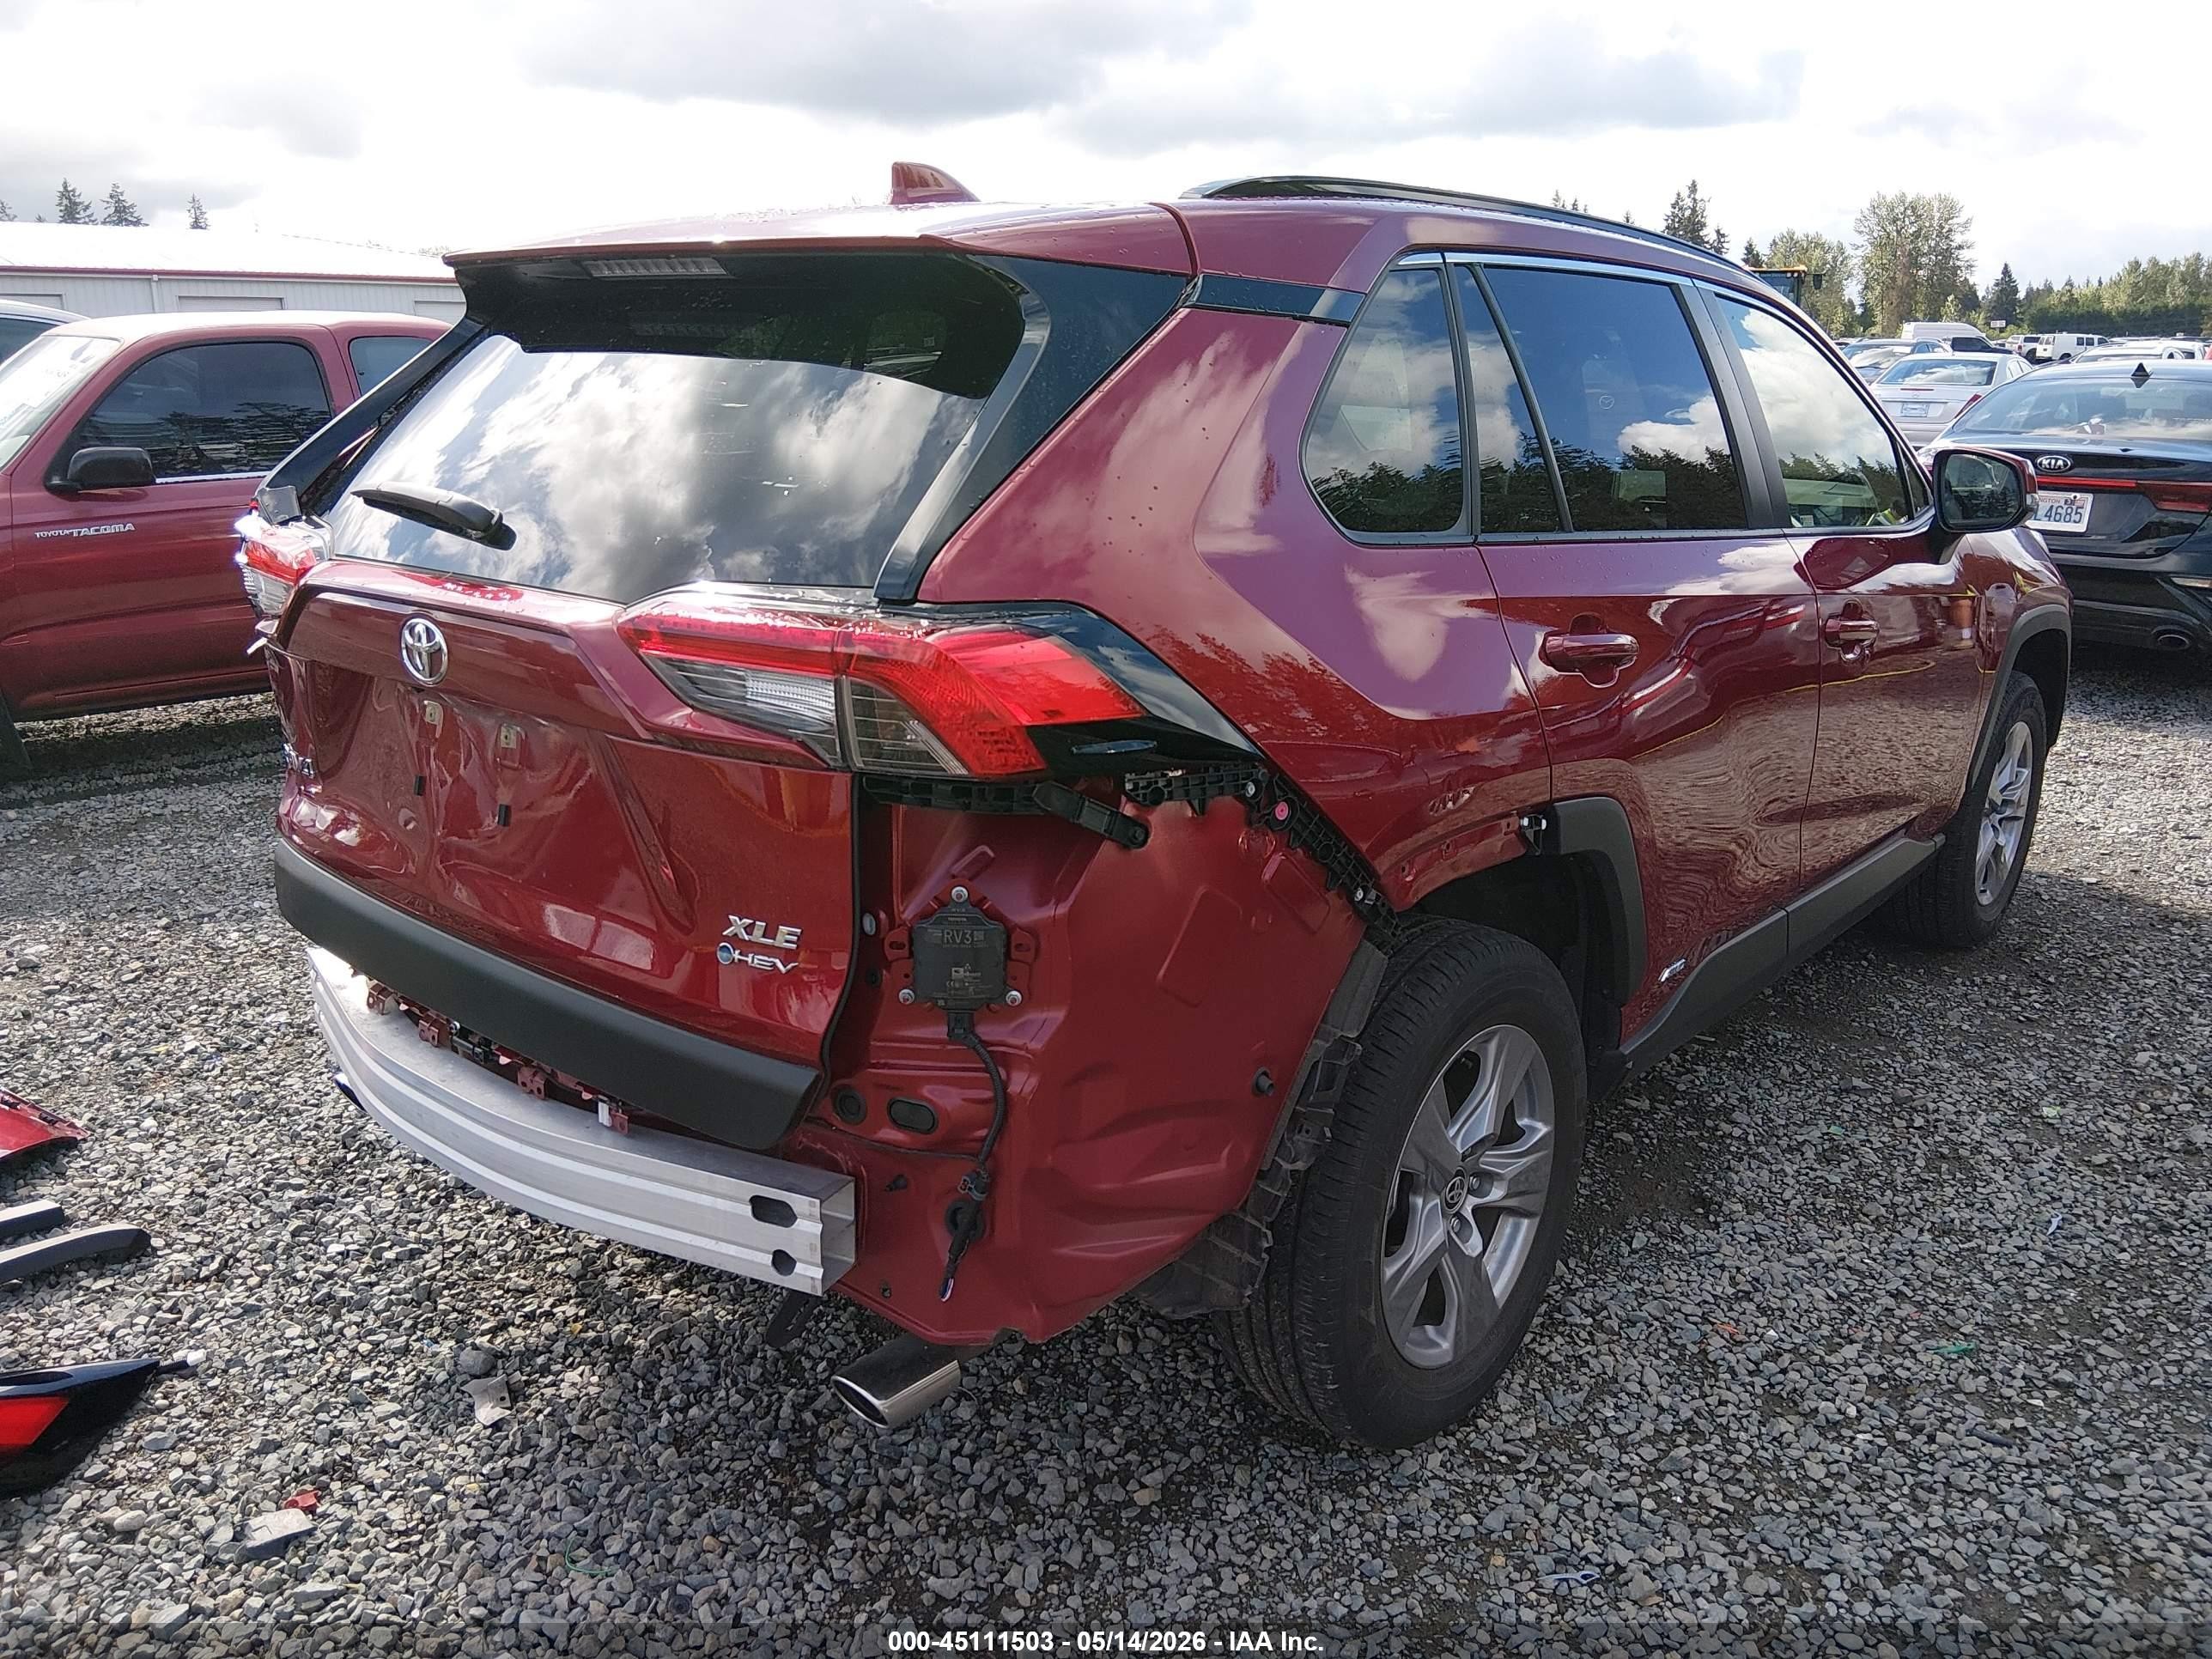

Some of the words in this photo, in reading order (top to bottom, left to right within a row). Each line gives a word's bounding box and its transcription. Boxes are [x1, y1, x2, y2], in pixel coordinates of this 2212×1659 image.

[2041, 459, 2064, 469] KIA
[2033, 504, 2083, 524] L4685
[34, 528, 69, 538] TOYOTA
[70, 523, 136, 537] TACOMA
[722, 915, 802, 950] XLE
[944, 929, 973, 945] RV3
